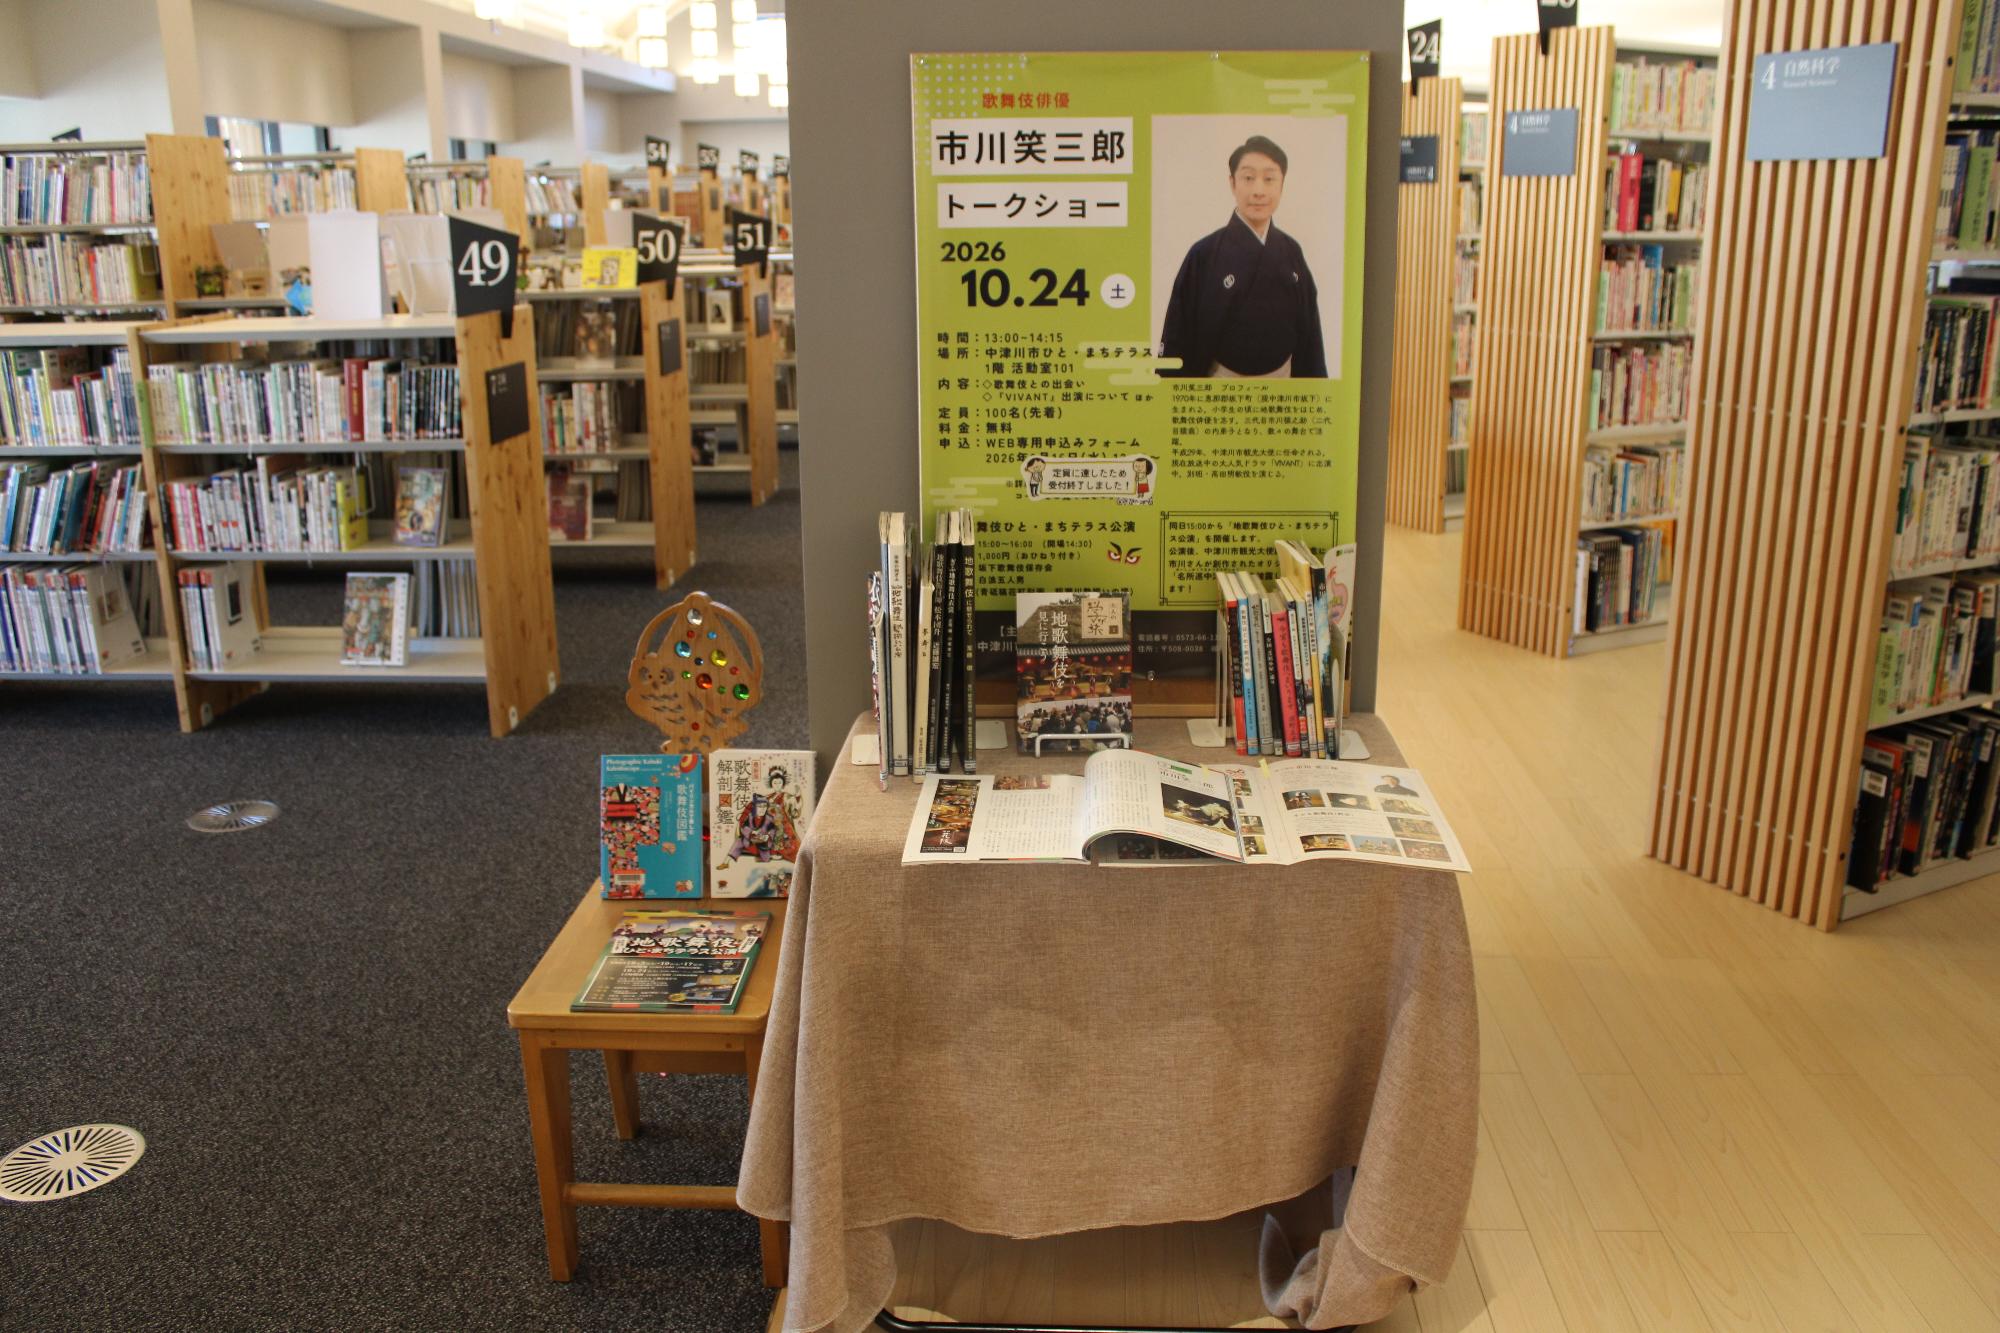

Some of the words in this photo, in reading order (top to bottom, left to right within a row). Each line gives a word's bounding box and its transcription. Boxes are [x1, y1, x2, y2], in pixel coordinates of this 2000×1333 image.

[1411, 30, 1440, 64] 24
[1761, 61, 1776, 90] 4
[981, 91, 1070, 110] 歌舞伎俳優
[1510, 114, 1518, 134] 4
[936, 129, 1127, 165] 市川笑三郎
[946, 192, 1121, 219] トークショー
[637, 228, 677, 265] 50
[737, 222, 767, 251] 51
[457, 239, 510, 287] 49
[940, 241, 1007, 262] 2026
[961, 267, 1091, 308] 10.24
[1110, 283, 1126, 300] 土
[1052, 468, 1127, 478] 定員に達したため
